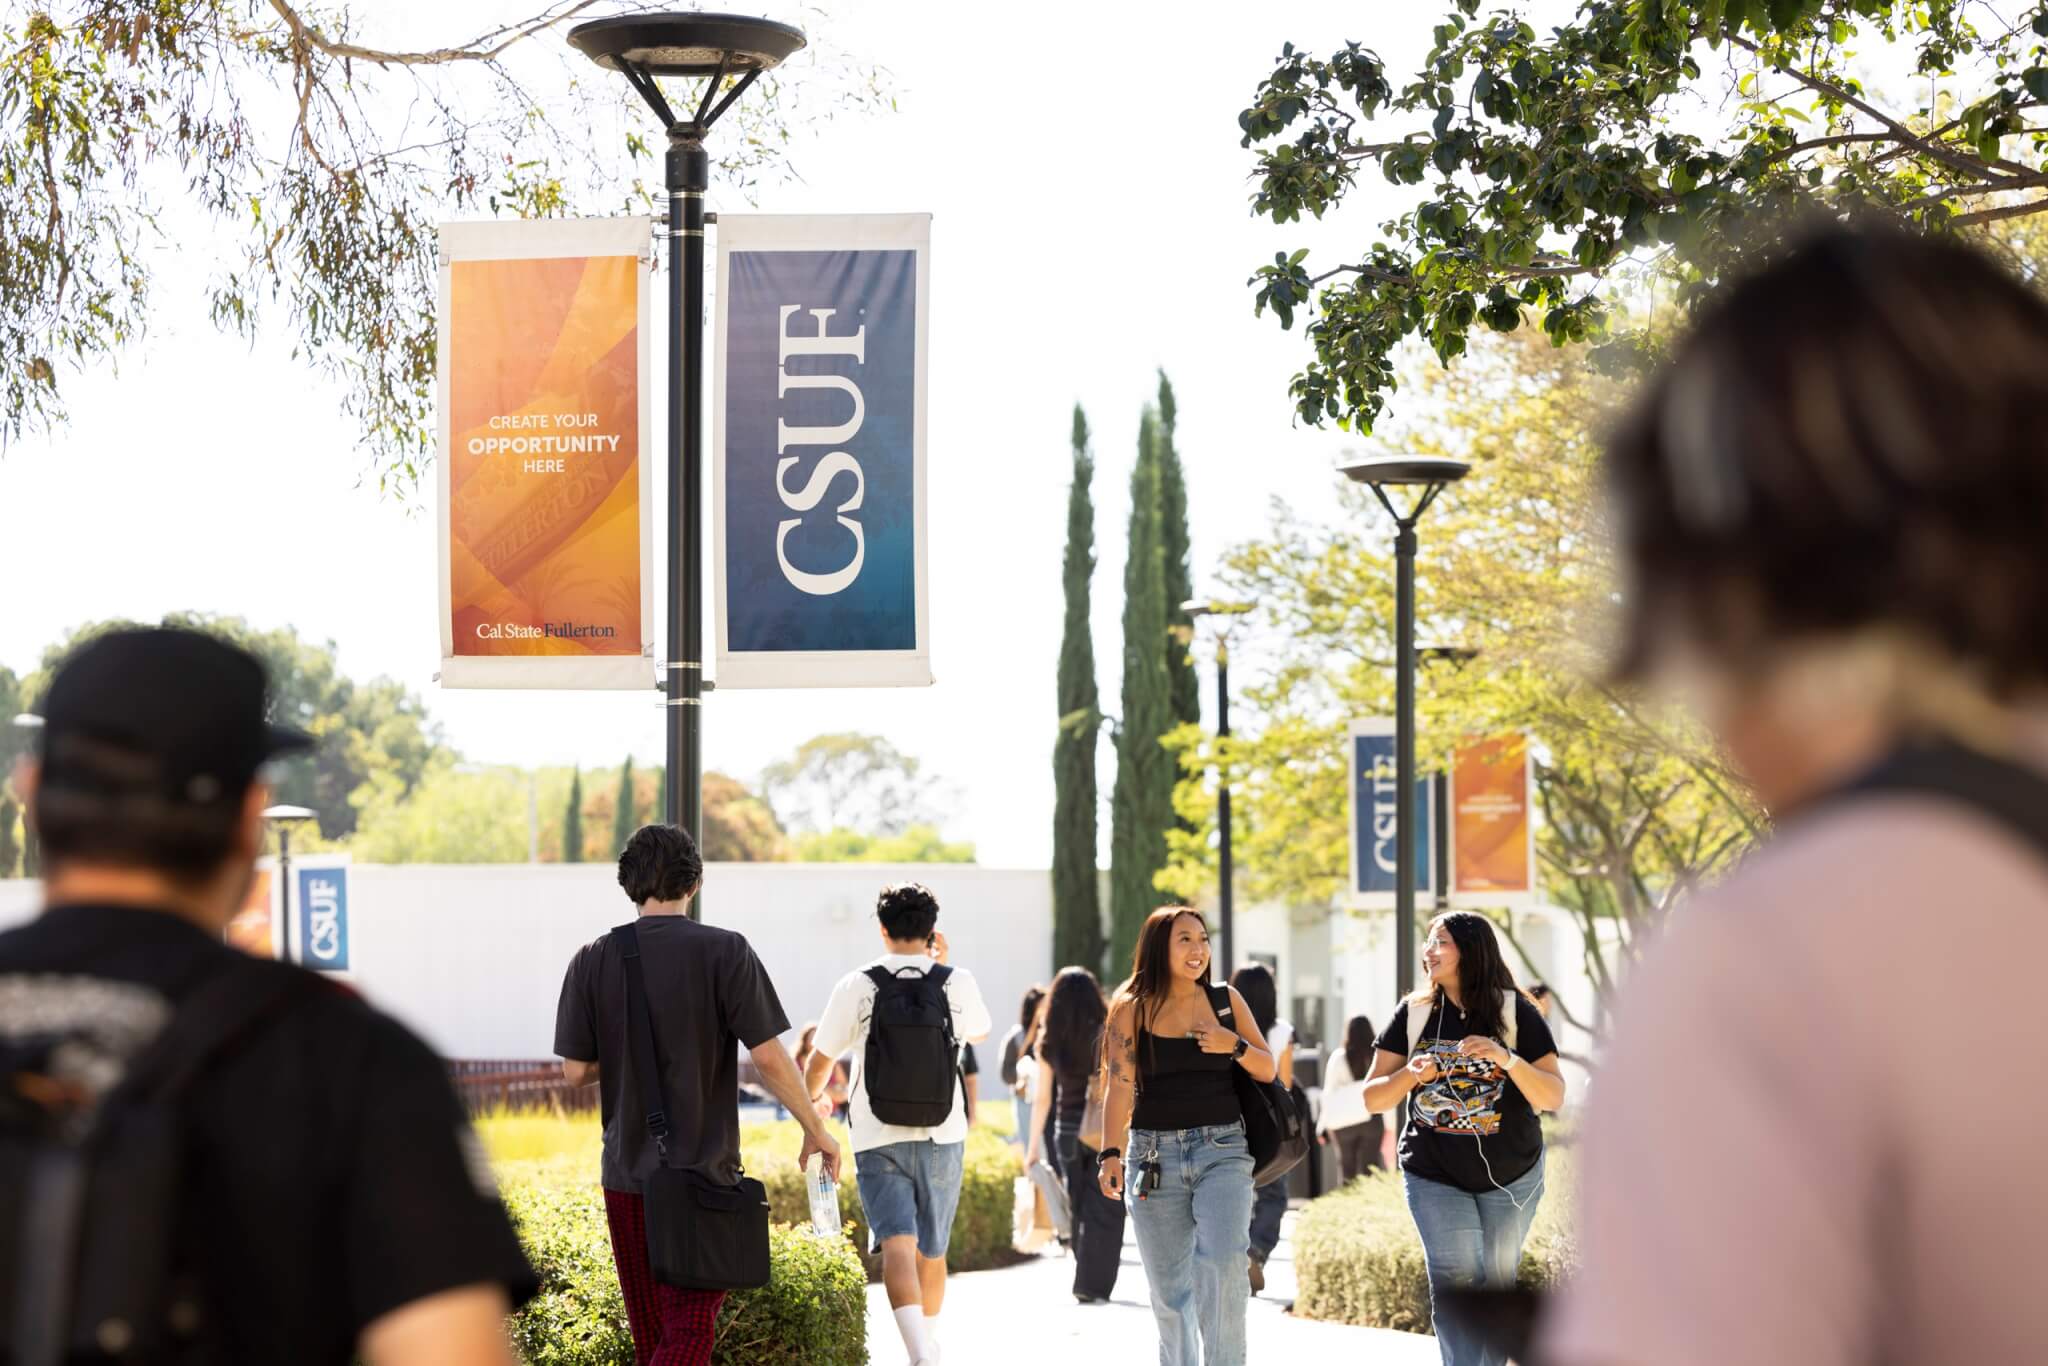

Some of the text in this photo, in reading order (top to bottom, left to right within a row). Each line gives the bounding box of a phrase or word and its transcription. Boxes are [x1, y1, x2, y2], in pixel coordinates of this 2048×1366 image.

[489, 414, 598, 429] CREATE YOUR
[468, 435, 620, 454] OPPORTUNITY
[776, 304, 866, 595] CSUF
[523, 459, 565, 473] HERE
[476, 622, 615, 640] Cal State Fullerton
[309, 878, 339, 961] CSUF
